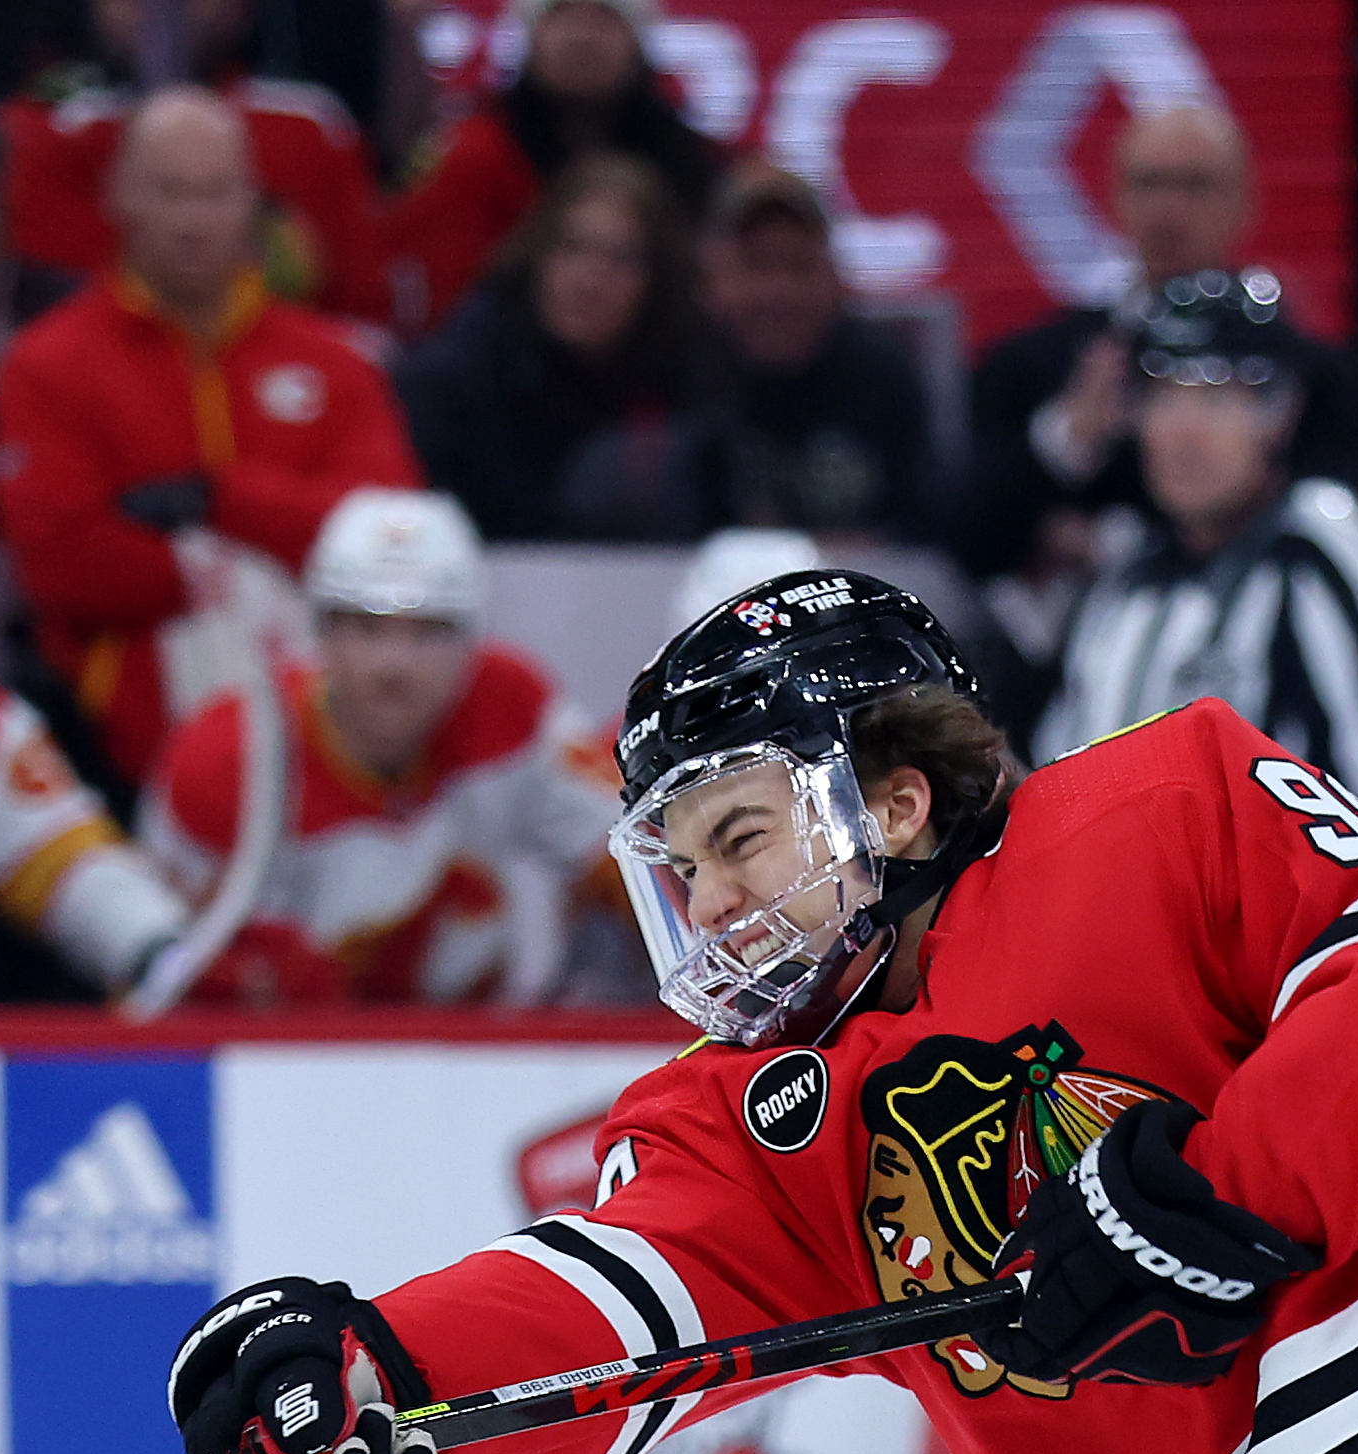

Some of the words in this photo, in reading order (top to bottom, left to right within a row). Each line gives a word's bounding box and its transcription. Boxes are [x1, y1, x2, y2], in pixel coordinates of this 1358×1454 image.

[779, 577, 853, 605] BELLE
[798, 591, 855, 614] TIRE
[754, 1068, 816, 1128] ROCKY
[558, 1361, 625, 1386] BEDARD
